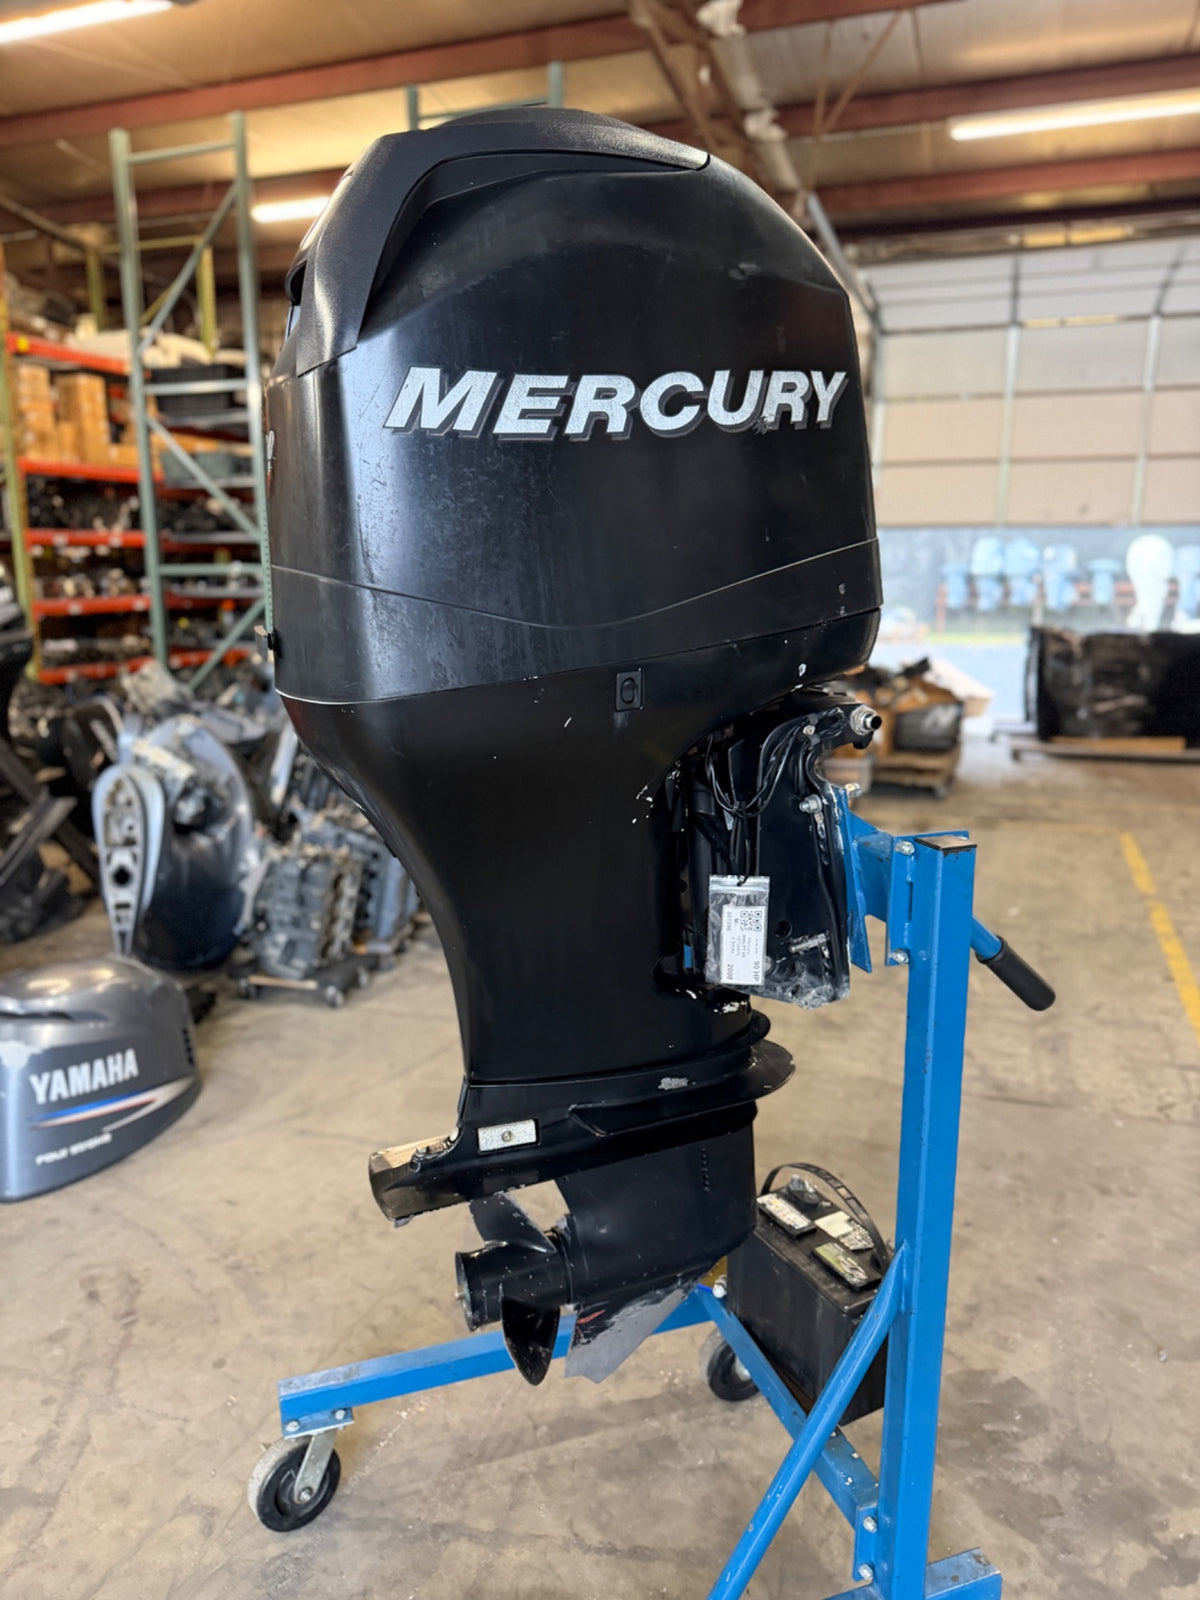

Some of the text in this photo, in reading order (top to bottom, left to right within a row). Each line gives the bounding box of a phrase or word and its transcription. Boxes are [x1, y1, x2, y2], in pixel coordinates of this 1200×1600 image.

[384, 366, 848, 440] MERCURY
[753, 961, 760, 970] 90
[753, 971, 760, 982] HP
[29, 1047, 139, 1105] YAMAHA
